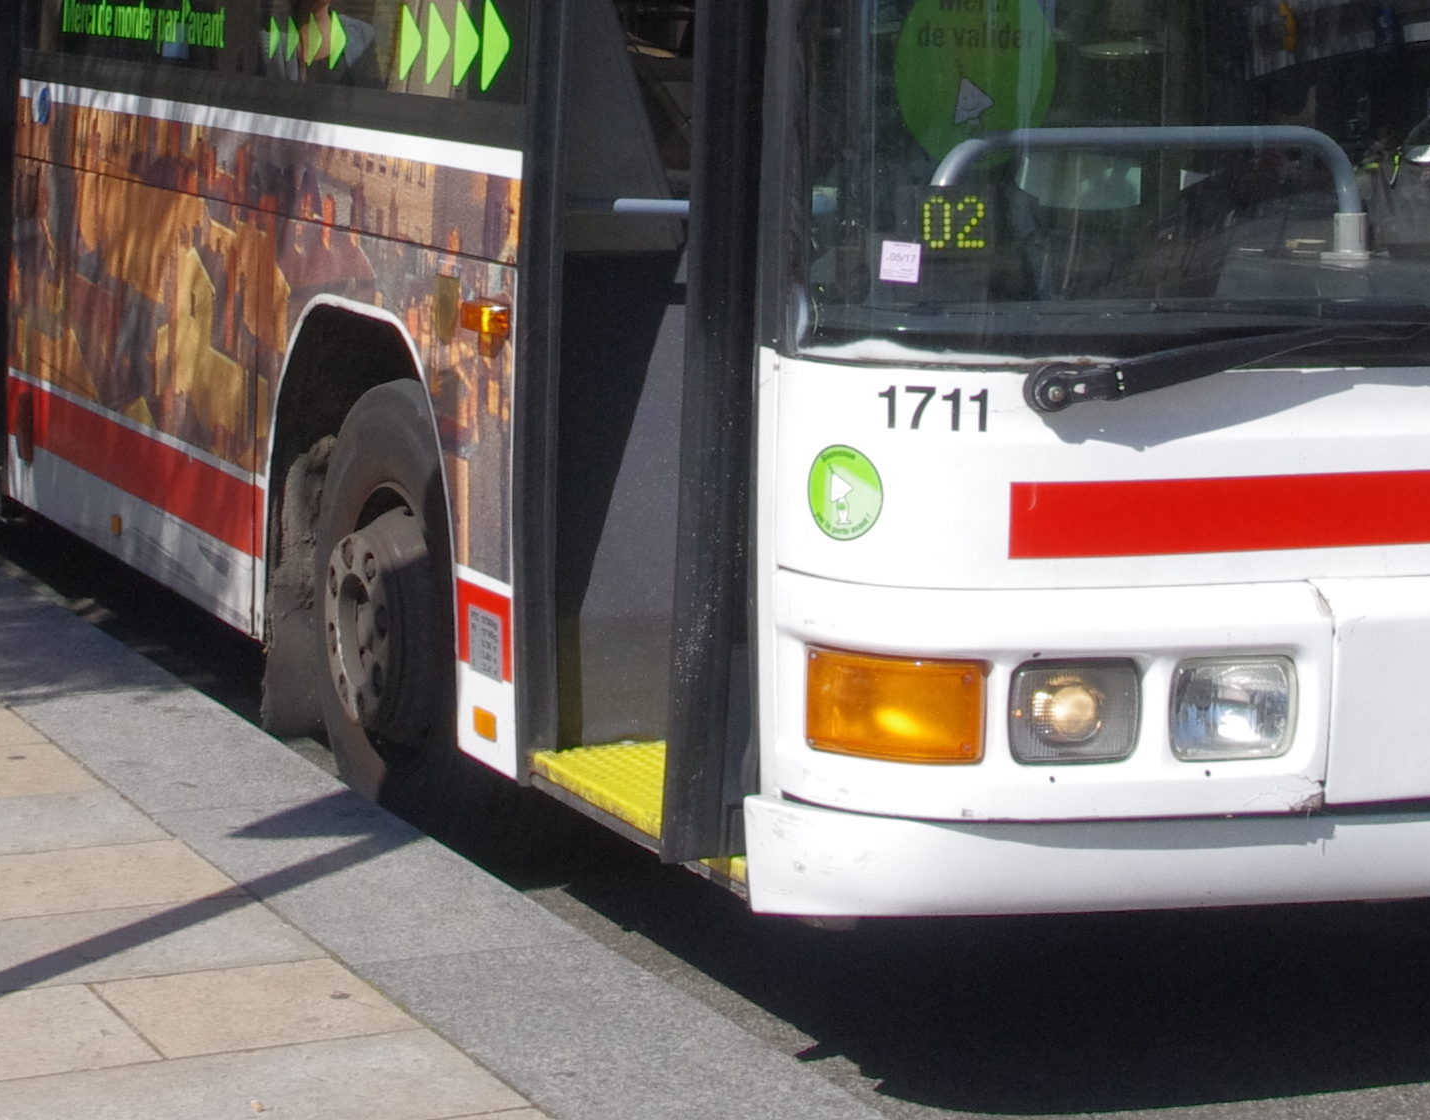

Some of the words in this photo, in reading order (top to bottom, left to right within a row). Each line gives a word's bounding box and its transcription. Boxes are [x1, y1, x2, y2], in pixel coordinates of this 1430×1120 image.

[114, 0, 157, 41] monter
[157, 7, 180, 54] par
[918, 19, 945, 48] de
[953, 19, 1035, 49] valider
[923, 195, 985, 249] 02
[878, 385, 989, 433] 1711
